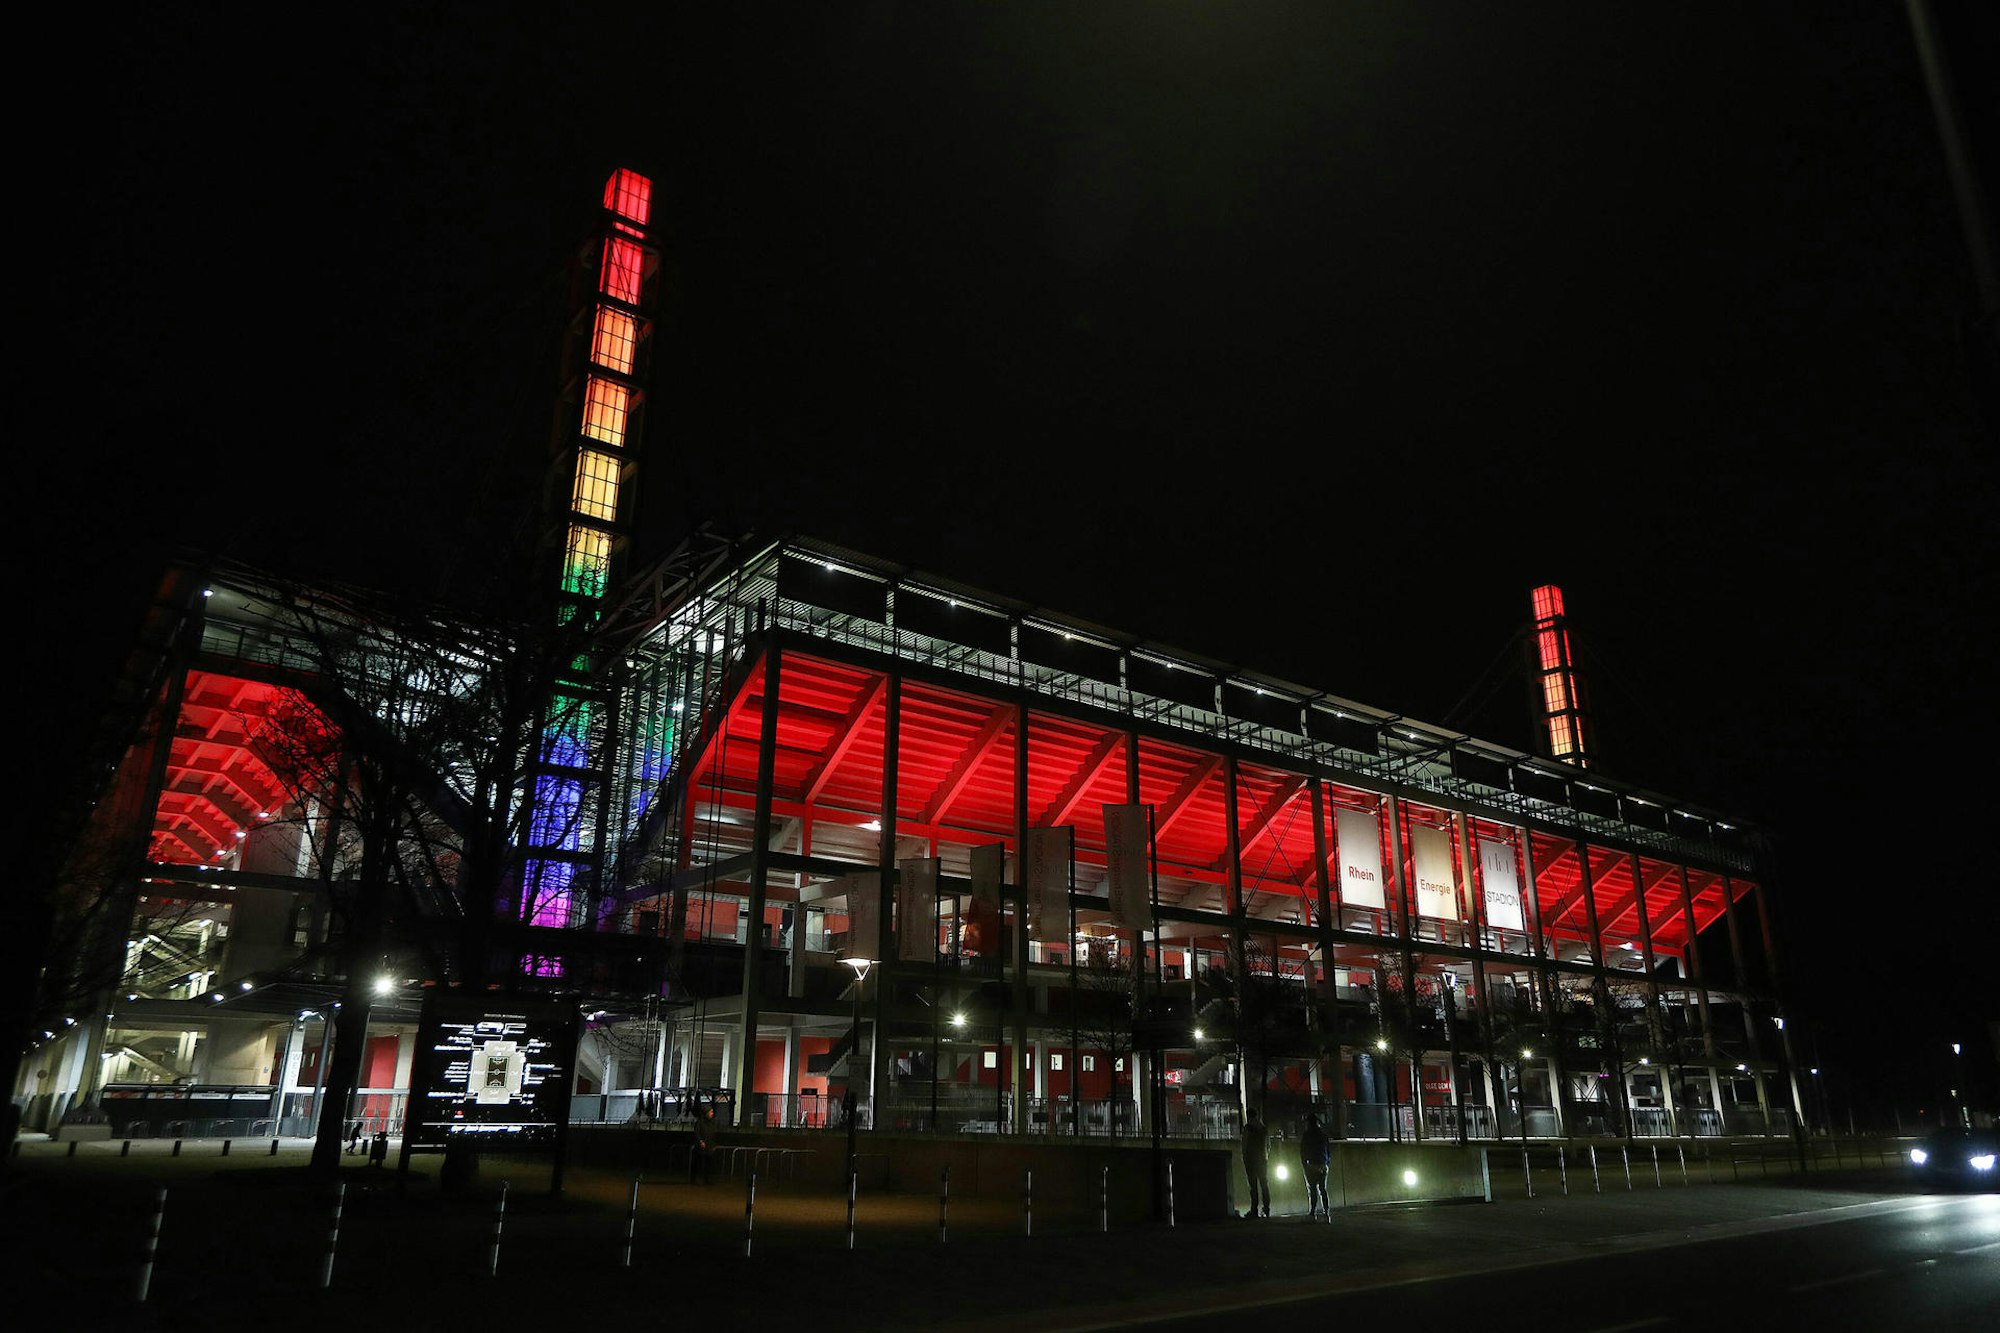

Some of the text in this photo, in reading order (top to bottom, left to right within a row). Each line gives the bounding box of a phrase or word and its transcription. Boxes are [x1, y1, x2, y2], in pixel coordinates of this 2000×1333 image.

[1348, 865, 1375, 882] Rhein
[1420, 878, 1451, 896] Energie
[1486, 890, 1519, 906] STADION
